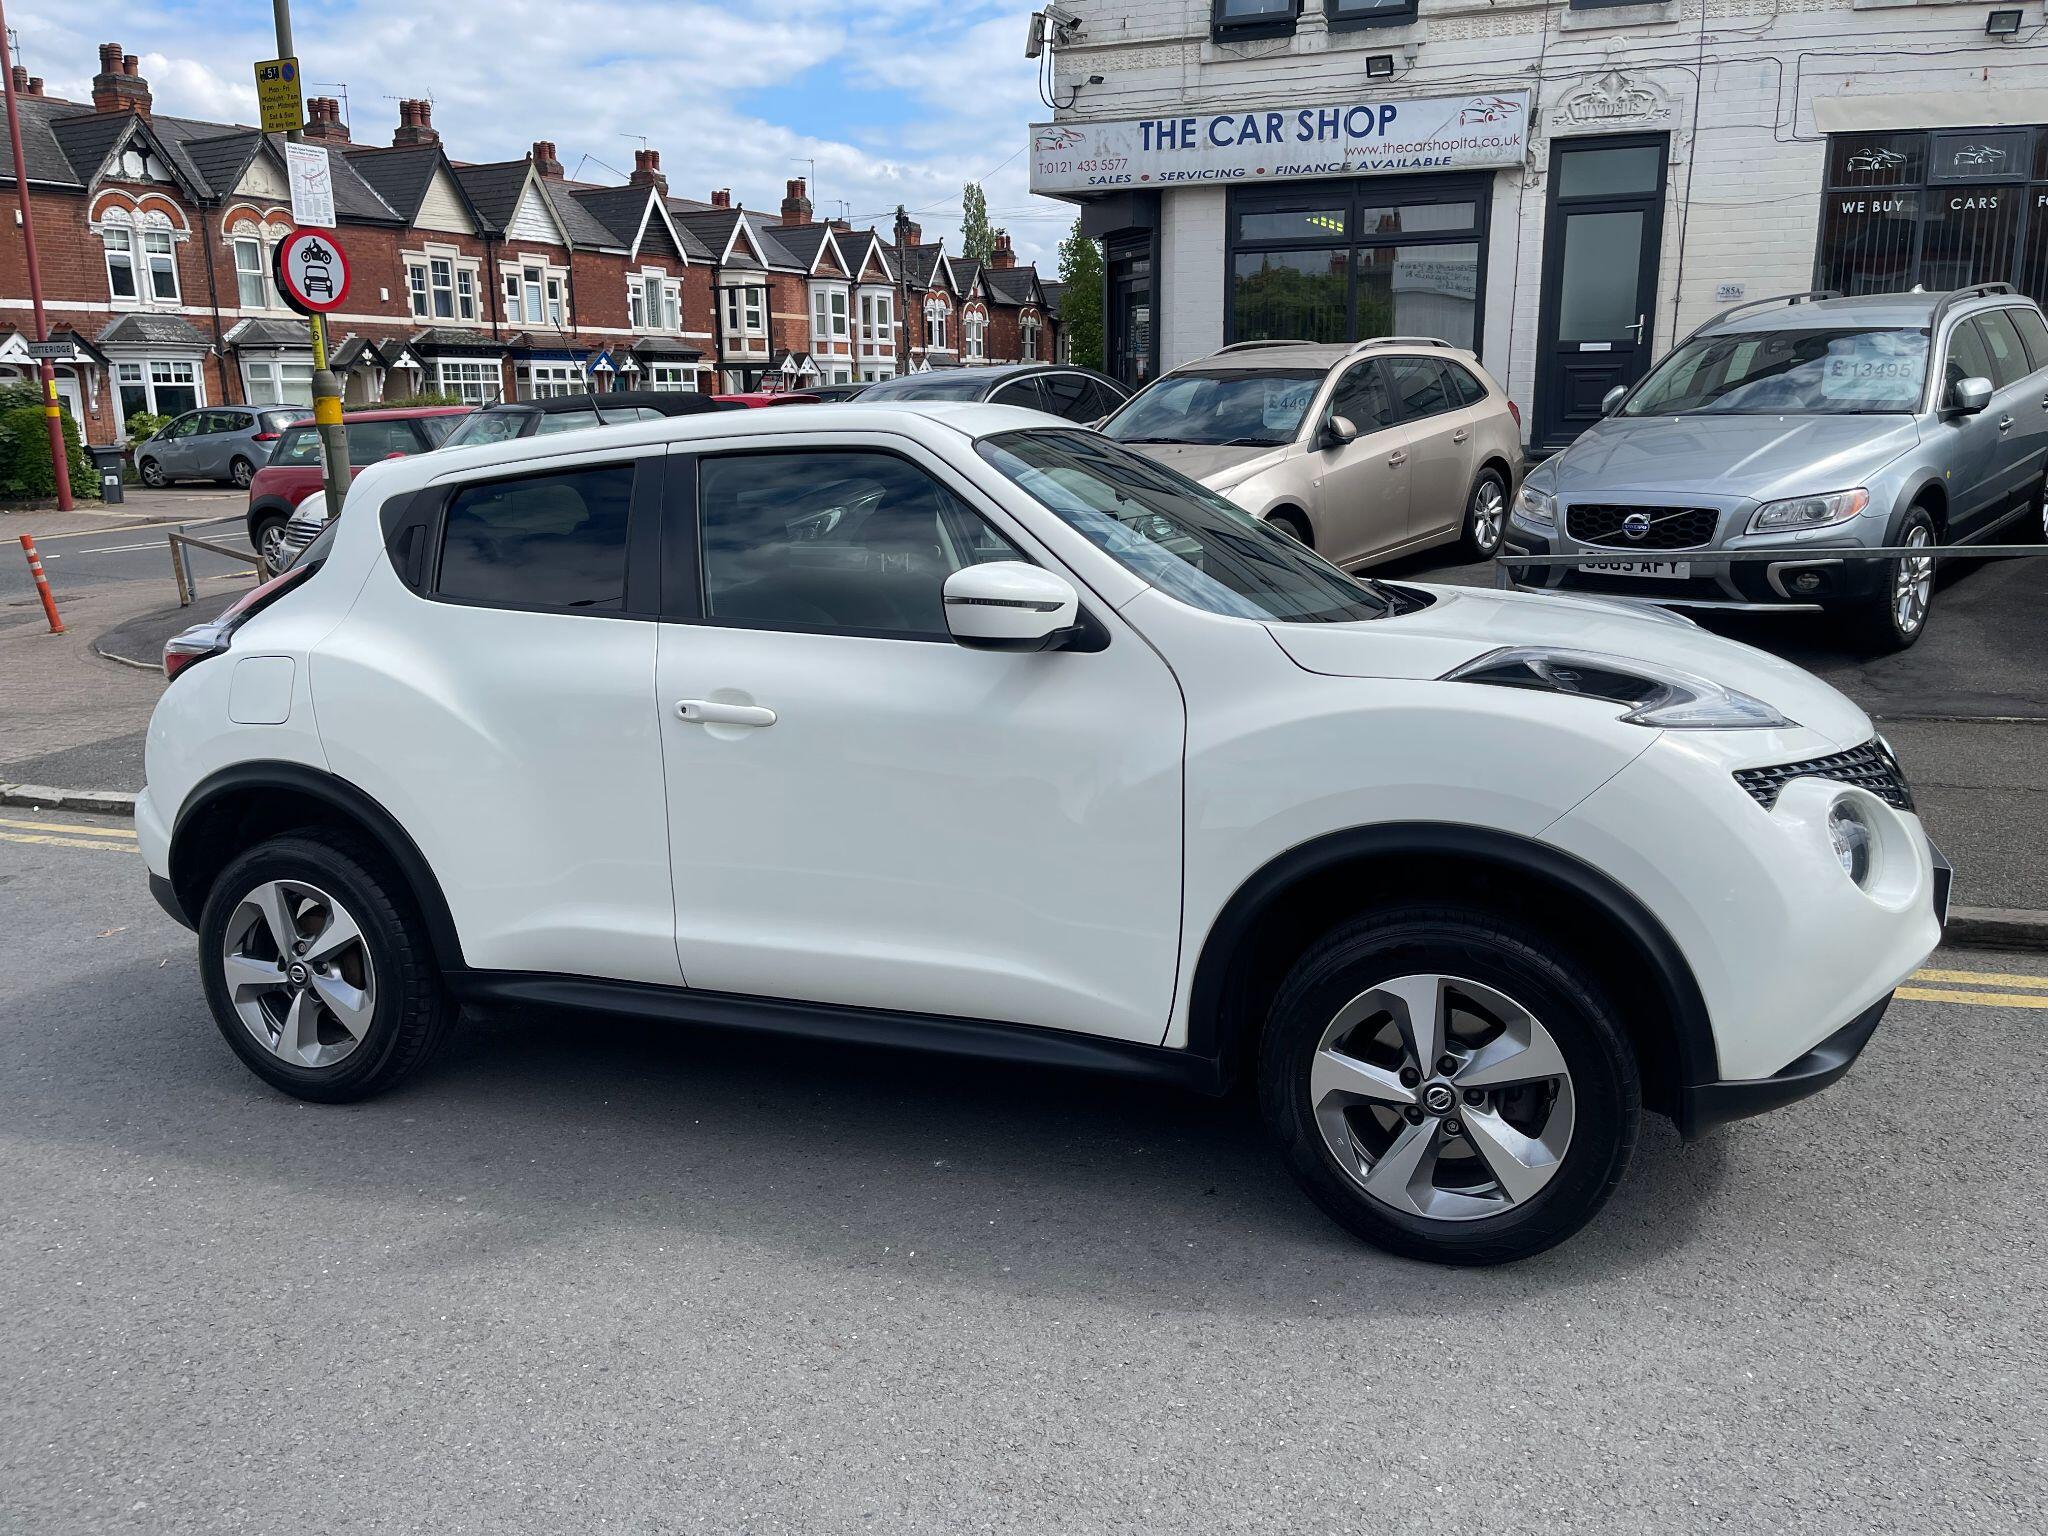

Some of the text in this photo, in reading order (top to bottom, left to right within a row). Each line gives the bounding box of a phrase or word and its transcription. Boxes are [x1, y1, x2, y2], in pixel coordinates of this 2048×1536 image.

[1139, 118, 1197, 151] THE
[1208, 112, 1284, 147] CAR
[1296, 104, 1397, 142] SHOP
[1343, 133, 1521, 156] www.thecarshopltd.co.uk
[1077, 160, 1098, 172] 433
[1100, 158, 1128, 171] 5577
[1088, 157, 1452, 185] SALES SERVICING FINANCE AVAILABLE
[1841, 202, 1865, 214] WE
[1872, 200, 1904, 213] BUY
[1950, 196, 1999, 210] CARS
[312, 330, 320, 341] 6
